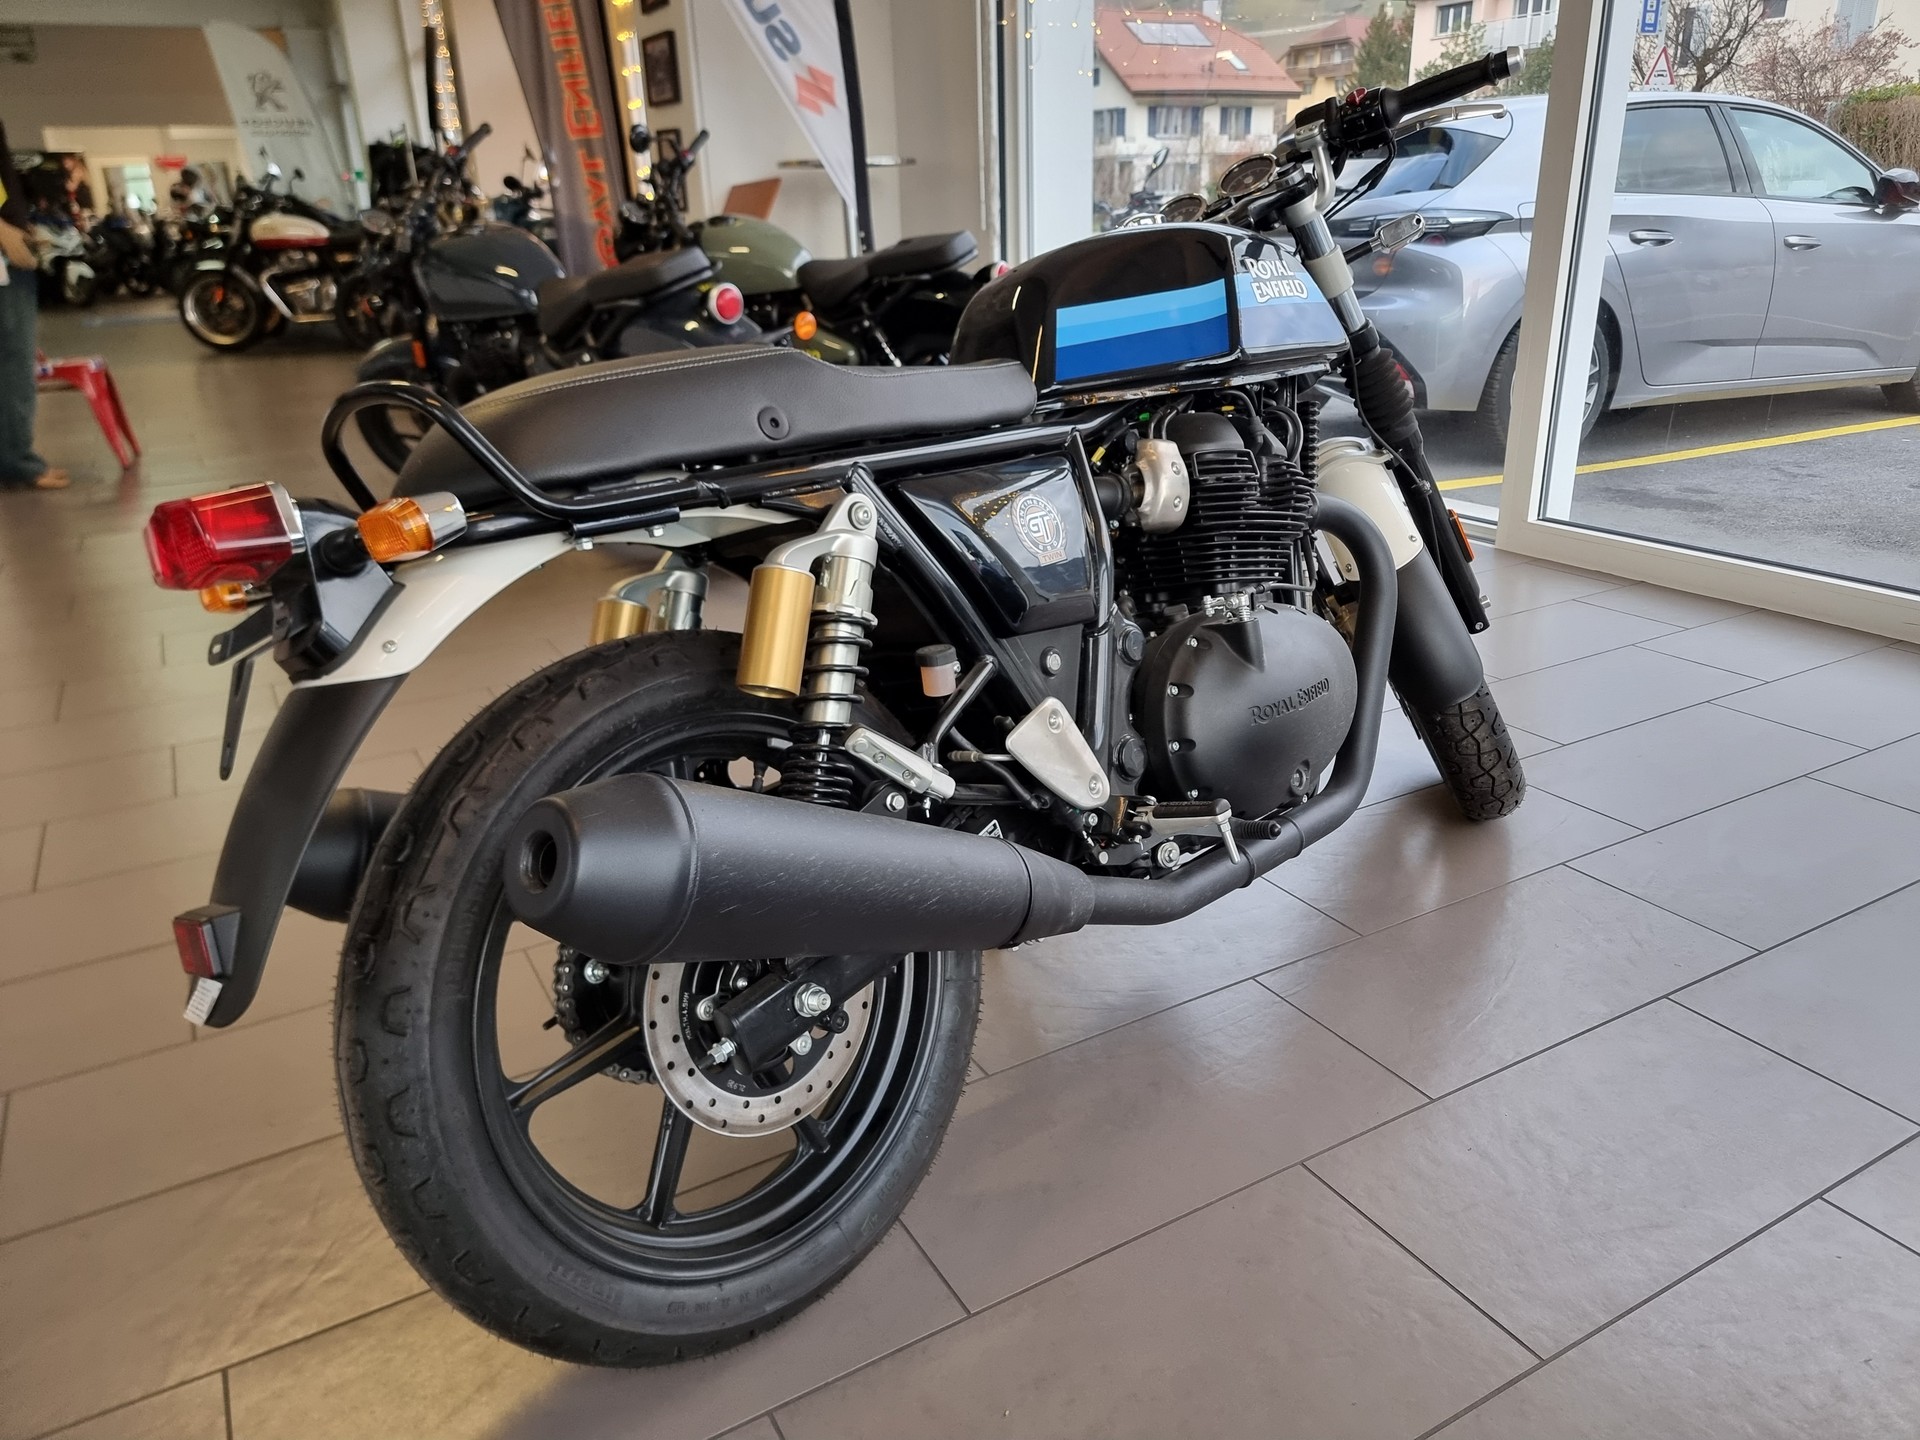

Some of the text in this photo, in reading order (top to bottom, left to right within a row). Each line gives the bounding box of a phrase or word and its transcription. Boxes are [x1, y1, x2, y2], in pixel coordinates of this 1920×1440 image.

[1242, 258, 1295, 279] ROYAL
[1250, 279, 1308, 303] ENFIELD
[1020, 499, 1058, 533] CONTINENTAL
[1026, 511, 1051, 543] GT
[1042, 551, 1063, 562] TWIN
[1248, 696, 1296, 725] ROYAL
